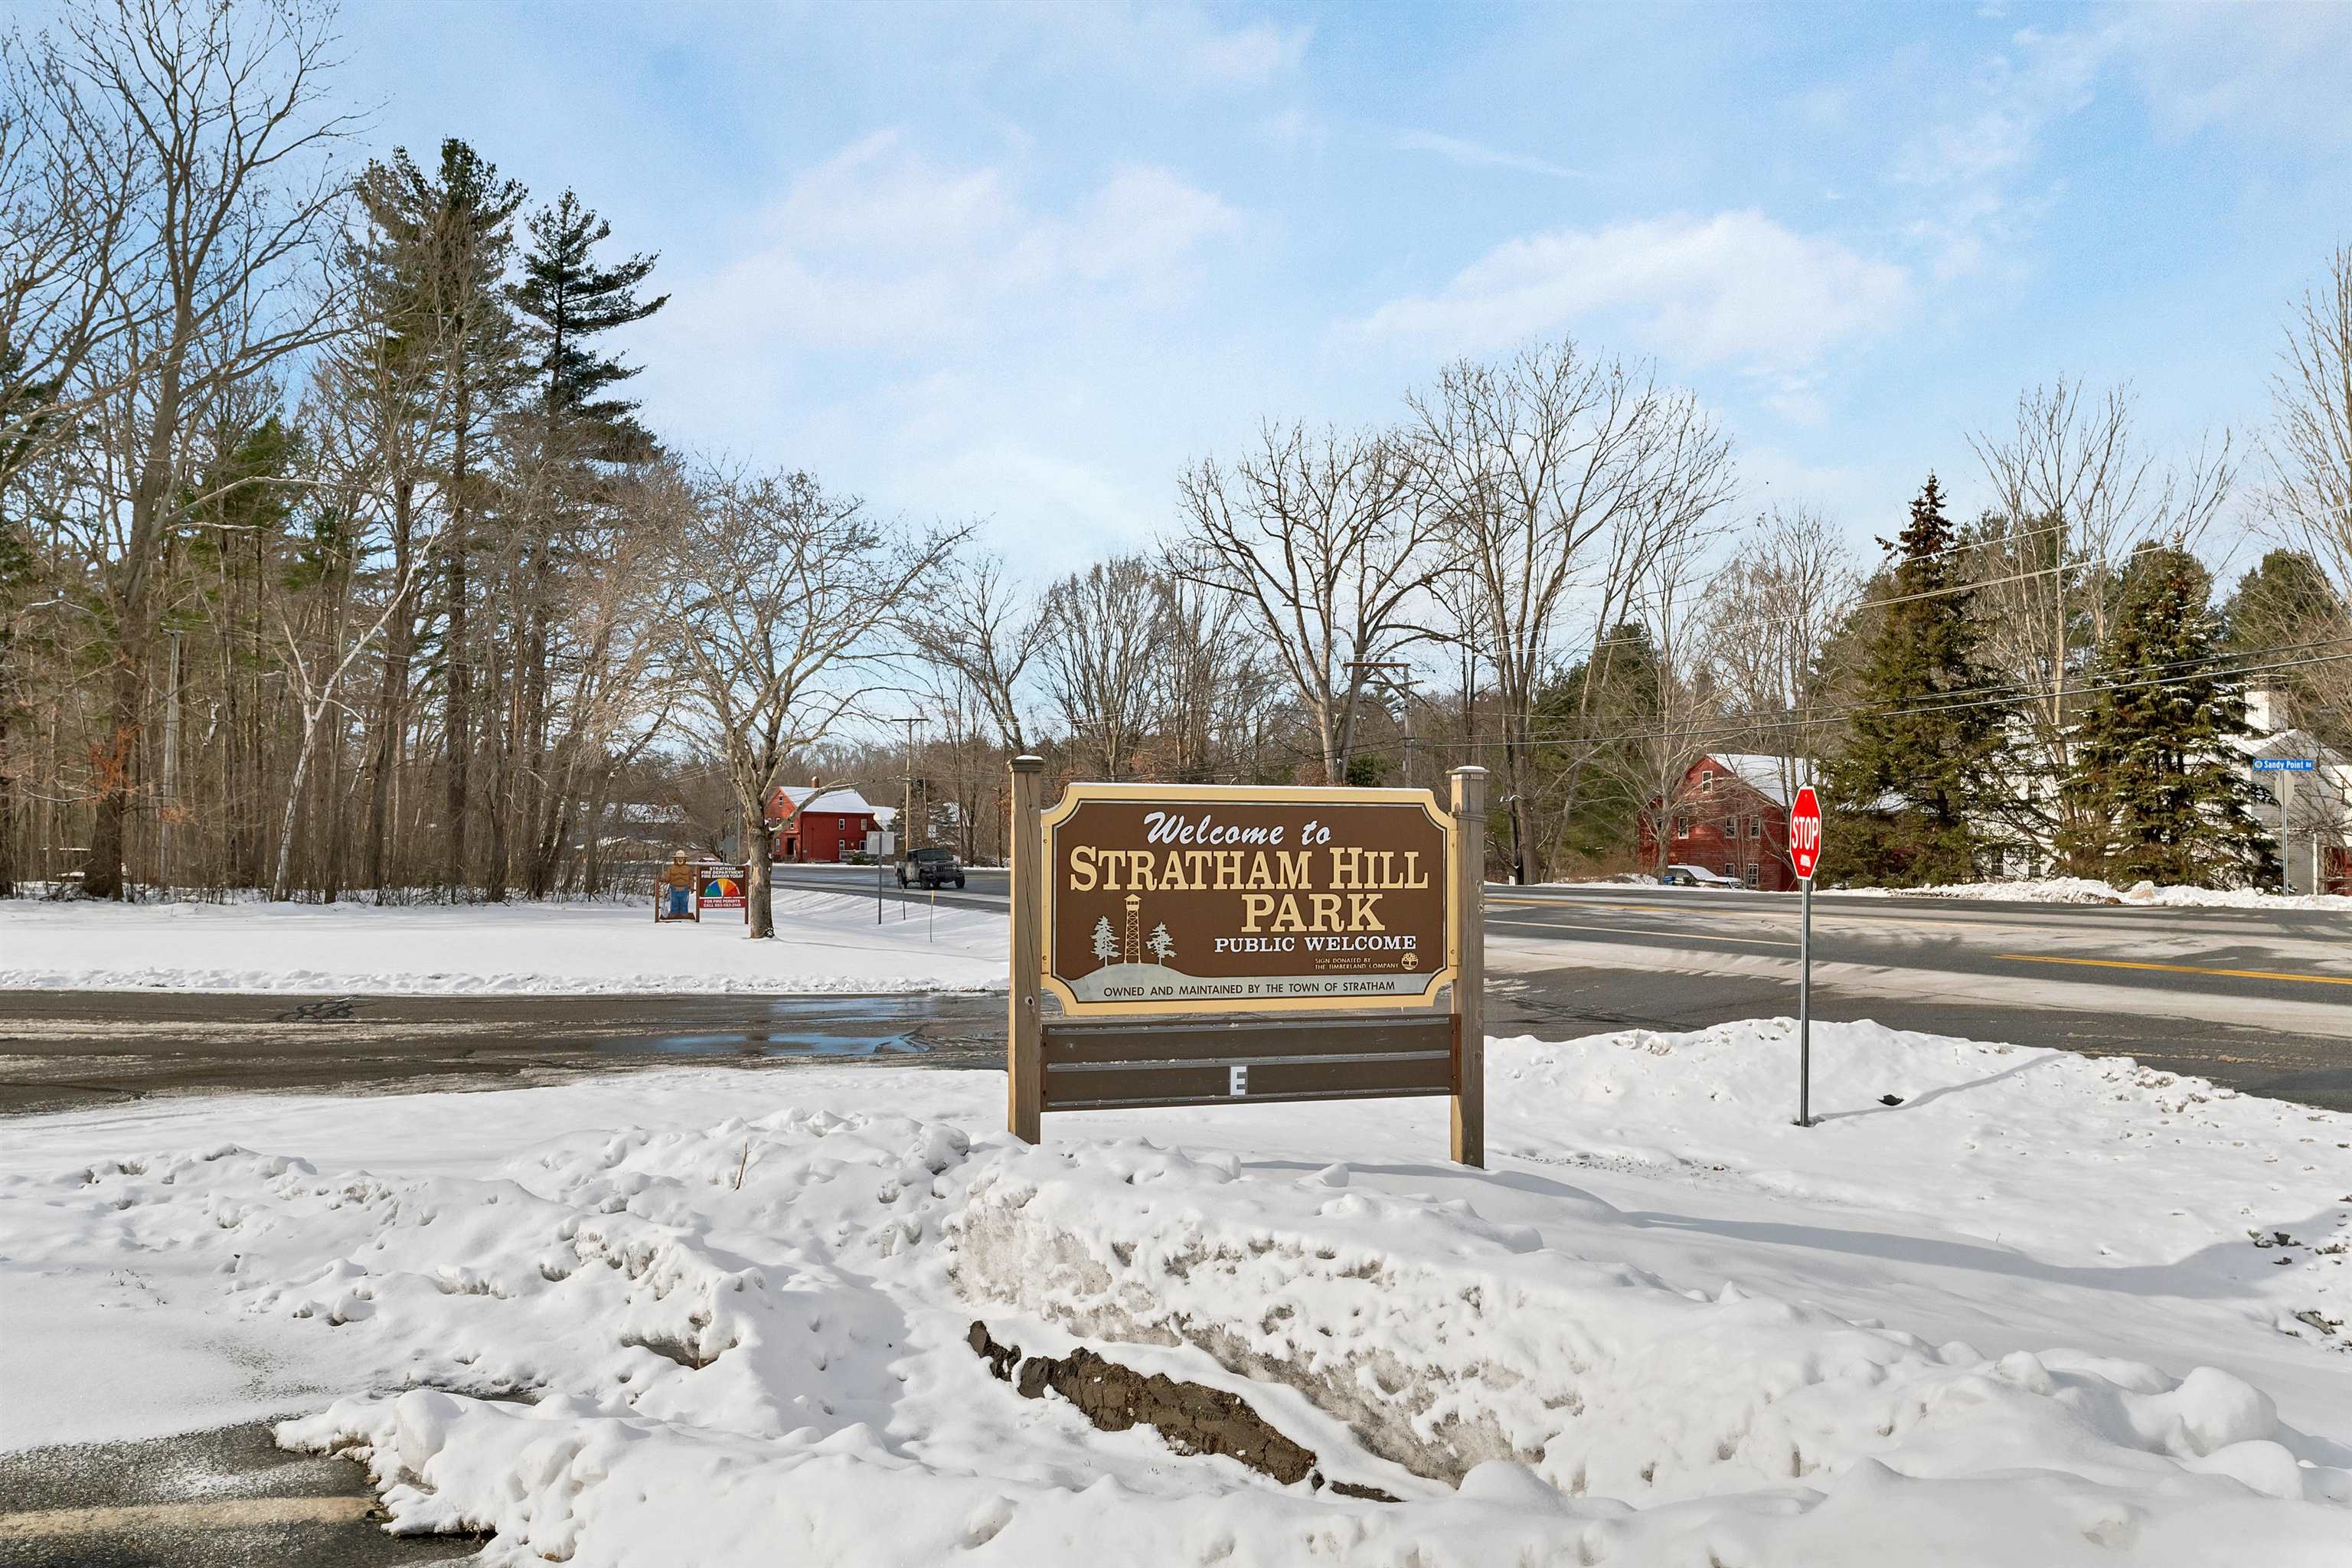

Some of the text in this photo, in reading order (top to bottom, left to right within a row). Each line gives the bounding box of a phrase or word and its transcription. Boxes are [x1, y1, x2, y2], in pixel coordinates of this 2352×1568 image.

[2263, 760, 2285, 770] Sandy
[2286, 760, 2304, 769] Point
[1143, 811, 1331, 845] Welcome to
[1792, 815, 1819, 851] STOP
[1070, 845, 1429, 891] STRATHAM HILL
[1240, 893, 1386, 933] PARK
[1214, 935, 1416, 953] PUBLIC WELCOME
[1103, 981, 1395, 997] OWNED AND MAINTAINED BY THE TOWN OF STRATHAM
[1230, 1066, 1247, 1096] E
